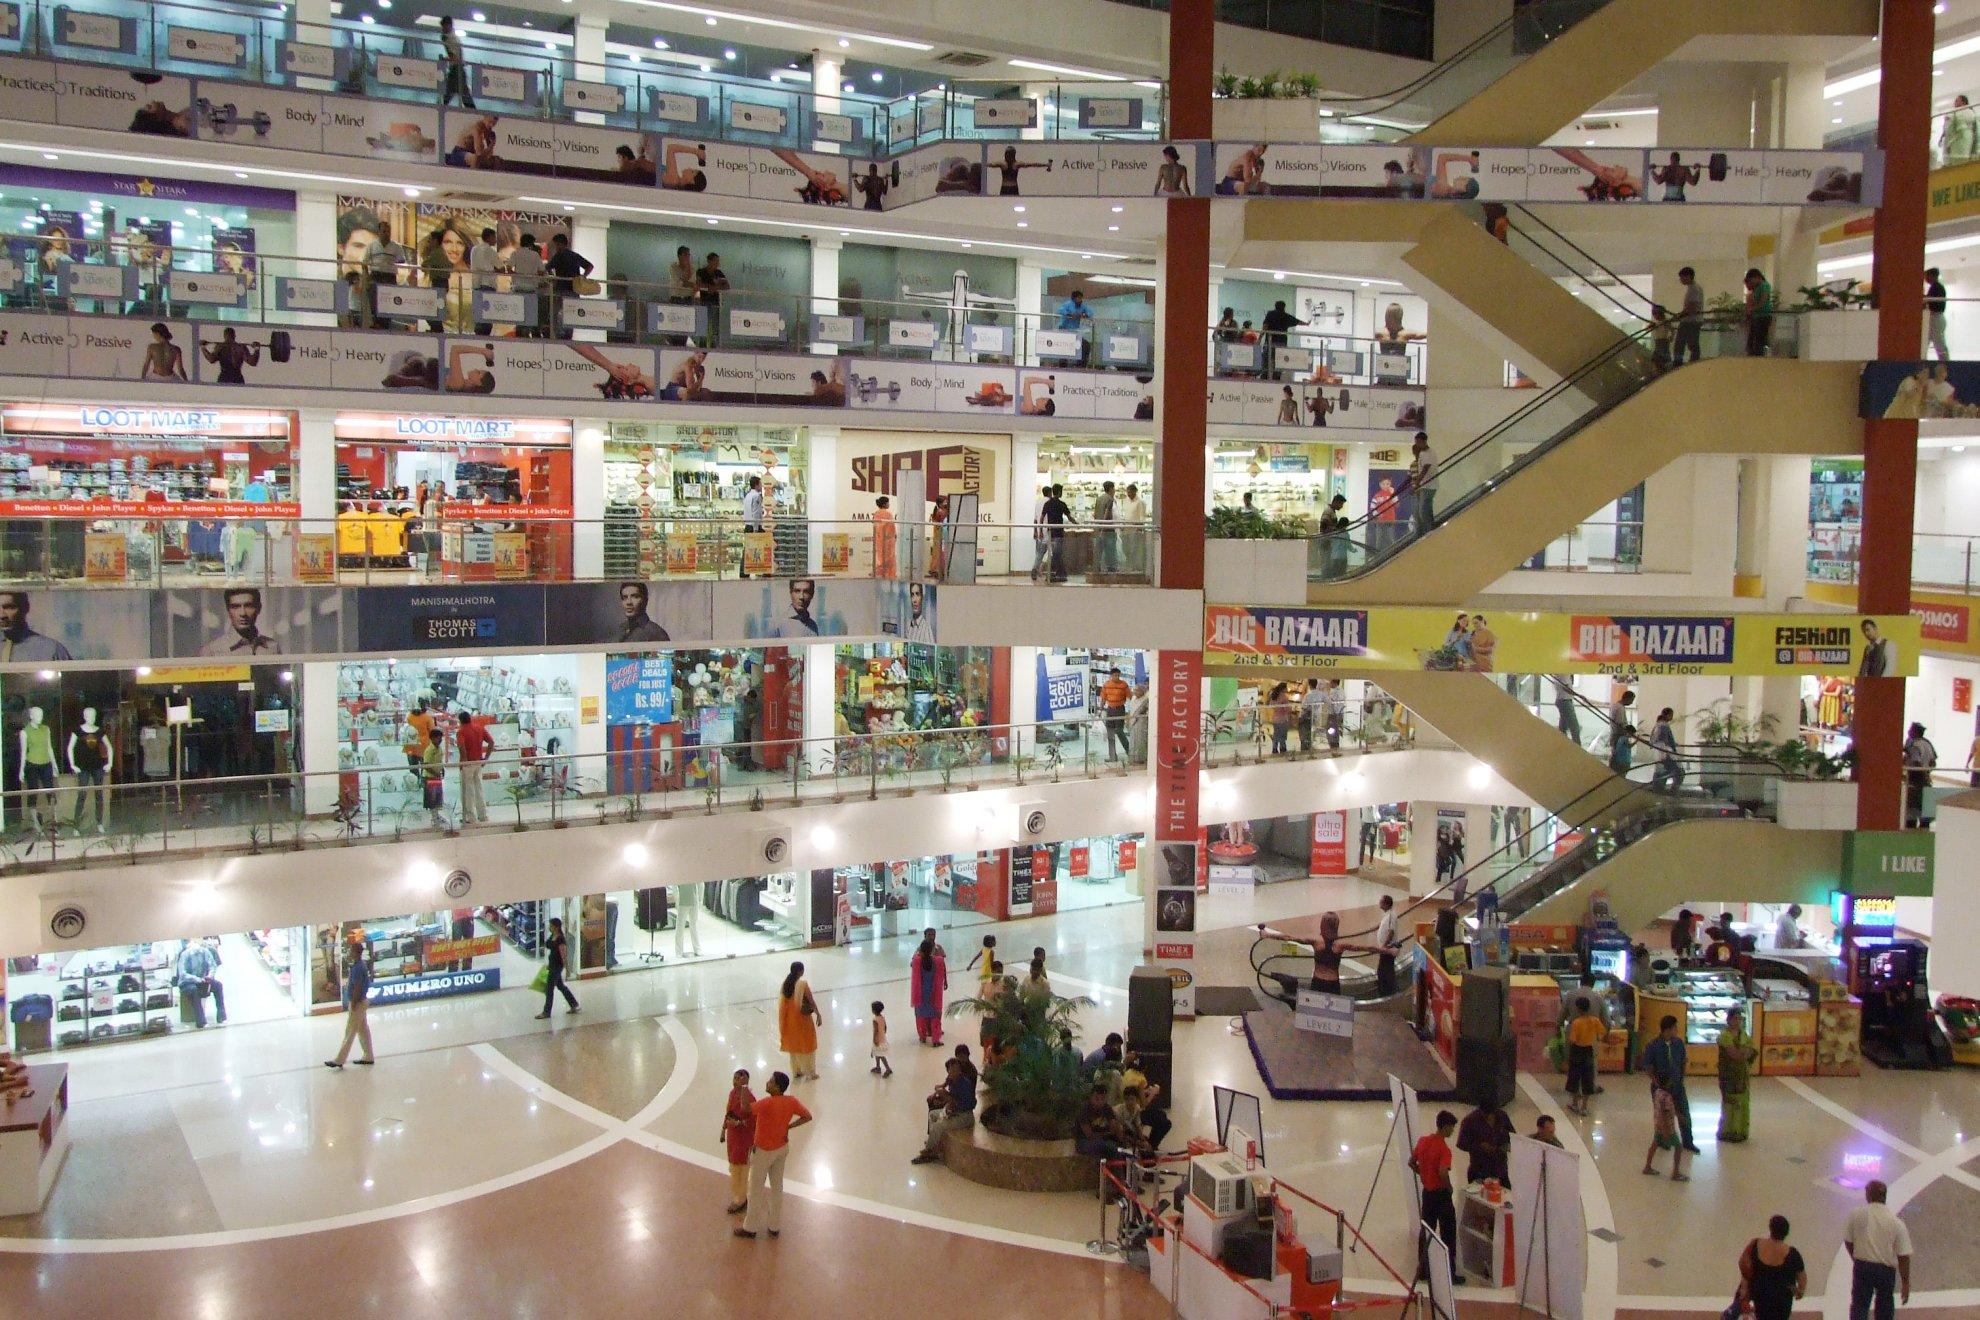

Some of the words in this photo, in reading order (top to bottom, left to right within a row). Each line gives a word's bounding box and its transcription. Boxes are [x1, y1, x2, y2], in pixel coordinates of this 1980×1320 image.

[69, 81, 136, 101] Traditions
[286, 108, 317, 125] Body
[334, 113, 365, 127] Mind
[507, 134, 552, 149] Missions
[563, 140, 600, 155] Visions
[717, 158, 749, 174] Hopes
[759, 162, 797, 177] Dreams
[1061, 158, 1095, 170] Active
[1111, 158, 1148, 171] Passive
[1275, 160, 1319, 171] Missions
[1330, 160, 1367, 172] Visions
[1491, 163, 1526, 176] Hopes
[1538, 164, 1581, 176] Dreams
[1735, 166, 1759, 177] Hale
[1776, 166, 1812, 179] Hearty
[337, 195, 410, 212] MATRIX
[421, 202, 493, 219] MATRIX
[501, 210, 567, 226] MATRIX
[20, 331, 64, 346] Active
[86, 334, 133, 348] Passive
[300, 346, 328, 359] Hale
[346, 349, 386, 364] Hearty
[507, 357, 542, 371] Hopes
[555, 359, 596, 372] Dreams
[714, 367, 754, 379] Missions
[764, 370, 796, 381] Visions
[910, 377, 932, 389] Body
[943, 378, 965, 389] Mind
[1062, 385, 1096, 395] Practices
[1102, 387, 1139, 397] Traditions
[82, 409, 144, 426] LOOT
[151, 411, 217, 427] MART
[398, 418, 453, 434] LOOT
[456, 420, 513, 435] MART
[676, 425, 698, 435] SHOE
[702, 424, 739, 436] CTORY
[112, 504, 137, 513] Player
[147, 504, 174, 513] Spykar
[255, 506, 273, 514] John
[274, 506, 297, 515] Player
[444, 507, 467, 516] Spykar
[550, 508, 570, 516] Player
[411, 596, 496, 606] MANISHMALHOTRA
[428, 619, 476, 628] THOMAS
[428, 627, 477, 638] SCOTT
[1214, 614, 1256, 645] BIG
[1264, 616, 1360, 648] BAZAAR
[1579, 624, 1621, 655] BIG
[1629, 625, 1726, 655] BAZAAR
[1234, 653, 1259, 665] 2nd
[1263, 653, 1272, 665] &
[1277, 653, 1298, 666] 3rd
[1303, 655, 1338, 667] Floor
[1779, 650, 1791, 662] @
[1814, 650, 1848, 661] BAZAAR
[644, 660, 665, 668] BEST
[1599, 663, 1623, 674] 2nd
[1628, 663, 1637, 674] &
[1642, 663, 1664, 674] 3rd
[1668, 664, 1704, 675] Floor
[642, 668, 667, 677] DEALS
[639, 681, 652, 689] FOR
[652, 679, 666, 688] JUST
[1057, 677, 1082, 697] 60%
[635, 692, 649, 708] Rs.
[650, 691, 669, 708] 99/-
[1049, 682, 1058, 709] FLAT
[1058, 694, 1083, 708] OFF
[1172, 658, 1188, 739] FACTORY
[1170, 798, 1186, 832] THE
[1317, 820, 1341, 830] ultra
[1317, 830, 1340, 838] sale
[1881, 855, 1888, 872] I
[1891, 855, 1926, 873] LIKE
[1036, 890, 1053, 899] JOHN
[1217, 887, 1239, 895] LEVEL
[1160, 945, 1188, 953] TIMEX
[382, 977, 452, 997] NUMERO
[453, 972, 486, 986] UNO
[1306, 1018, 1332, 1031] LEVEL
